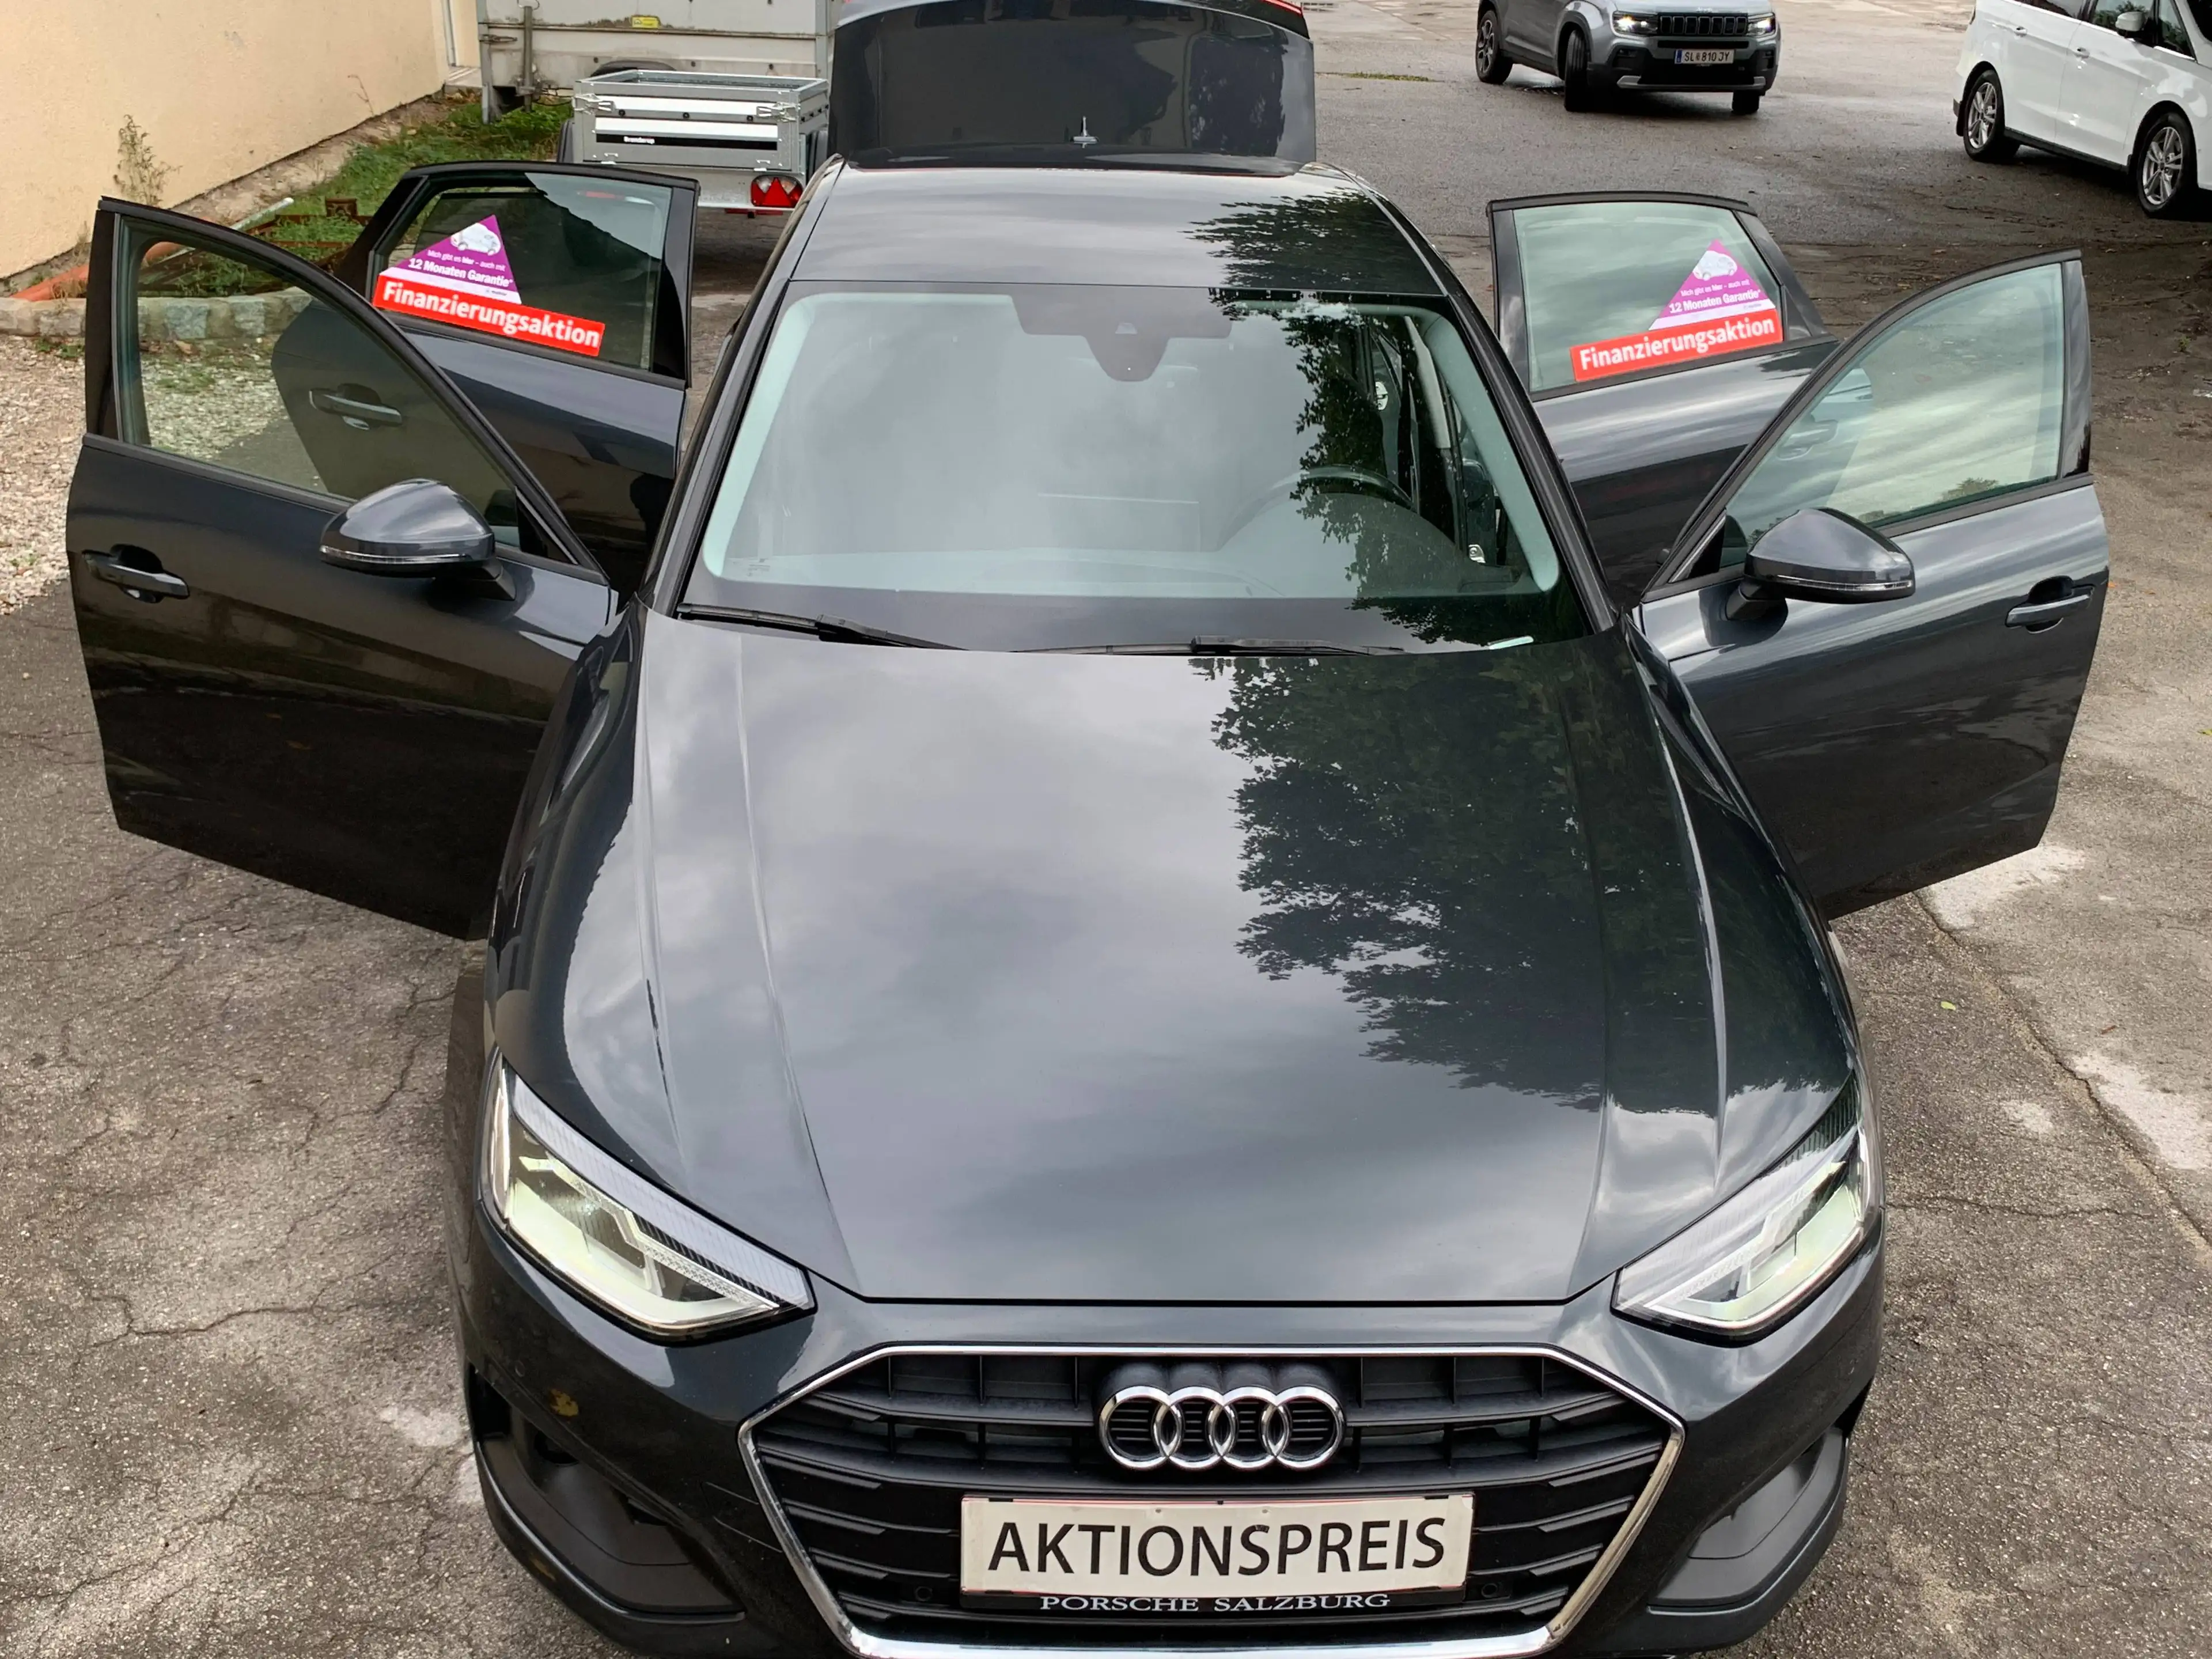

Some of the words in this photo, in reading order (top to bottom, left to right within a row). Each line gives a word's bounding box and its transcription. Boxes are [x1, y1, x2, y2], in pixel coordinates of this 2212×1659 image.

[1684, 52, 1694, 62] SL
[1702, 52, 1717, 62] 810
[1718, 51, 1729, 62] JY
[408, 258, 422, 270] 12
[423, 262, 467, 278] Monaten
[382, 281, 600, 349] Finanzierungsaktion
[1669, 303, 1683, 314] 12
[1683, 297, 1722, 312] Monaten
[1580, 317, 1775, 370] Finanzierungsaktion
[987, 1517, 1446, 1577] AKTIONSPREIS
[1040, 1596, 1199, 1612] PORSCHE
[1214, 1593, 1391, 1612] SALZBURG
